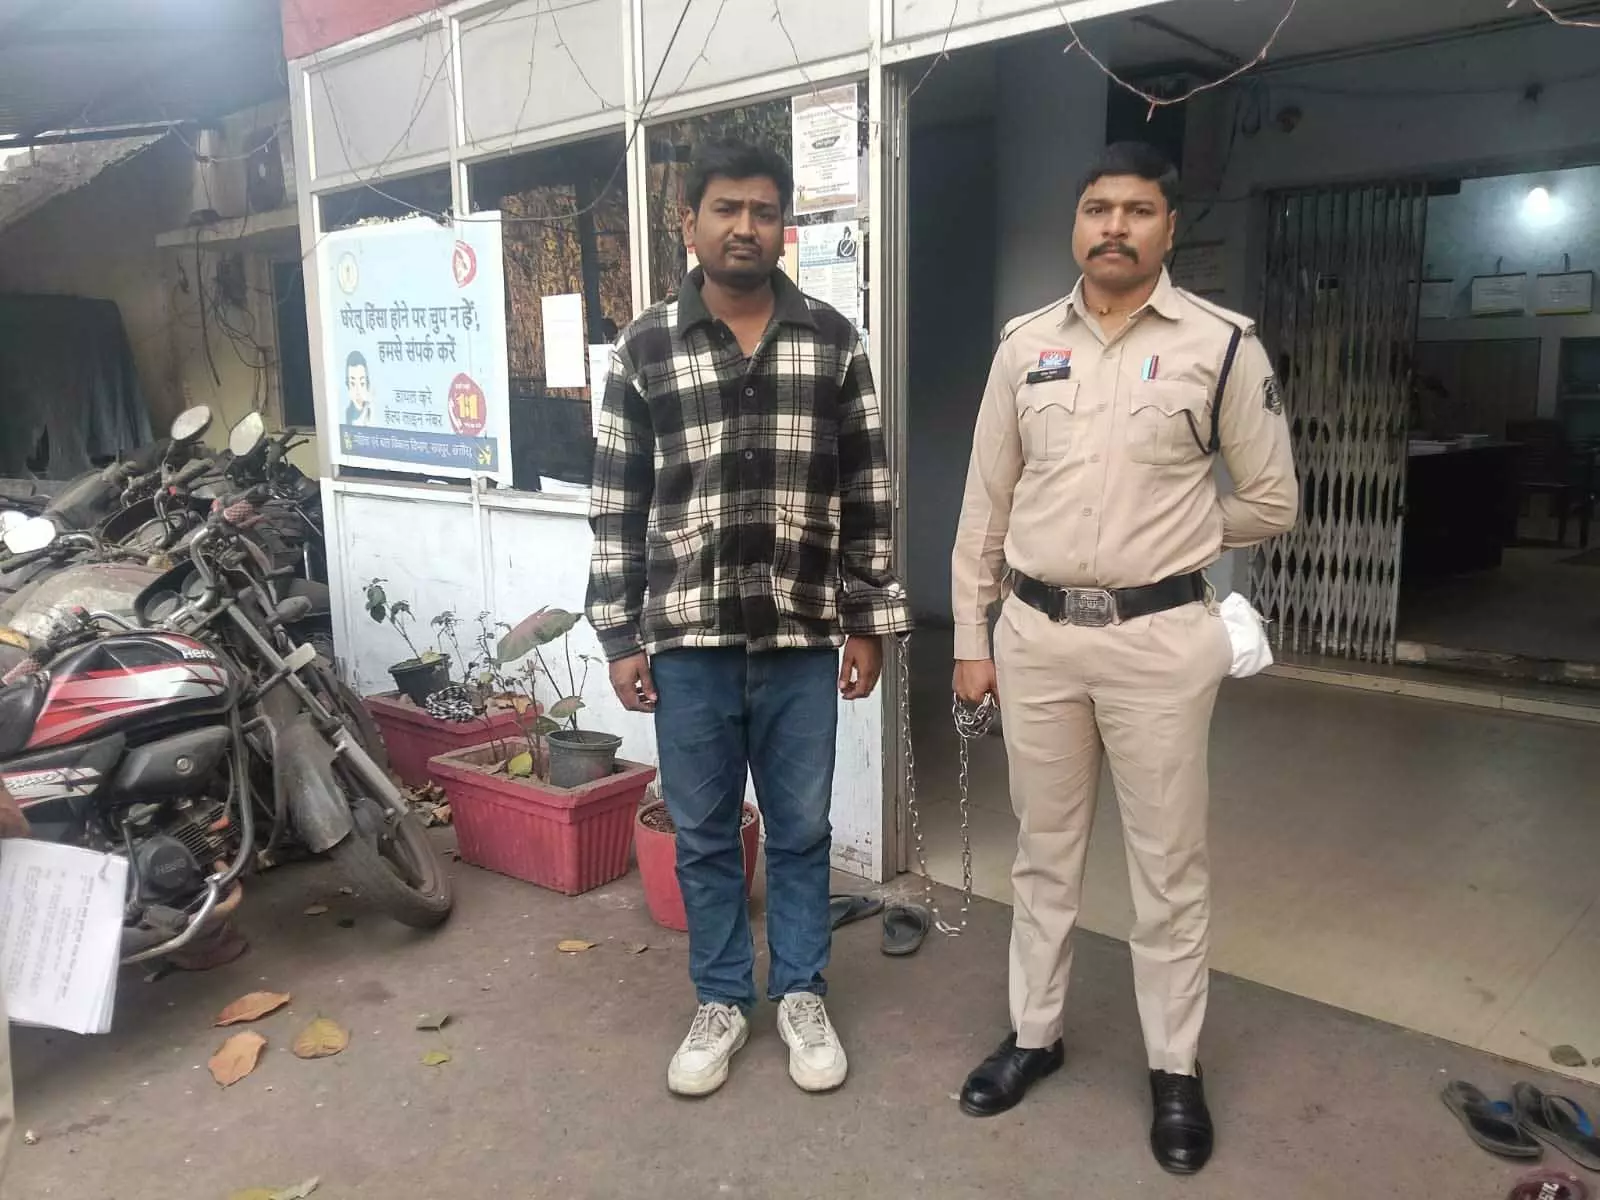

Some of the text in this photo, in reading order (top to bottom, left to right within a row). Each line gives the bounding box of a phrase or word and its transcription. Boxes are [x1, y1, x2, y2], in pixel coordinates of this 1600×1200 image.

[340, 301, 366, 334] घरेलू
[389, 300, 409, 331] होने
[411, 308, 427, 328] पर
[428, 307, 447, 334] चुप
[377, 334, 403, 363] हमसे
[405, 333, 434, 362] संपर्क
[181, 649, 216, 659] Hero
